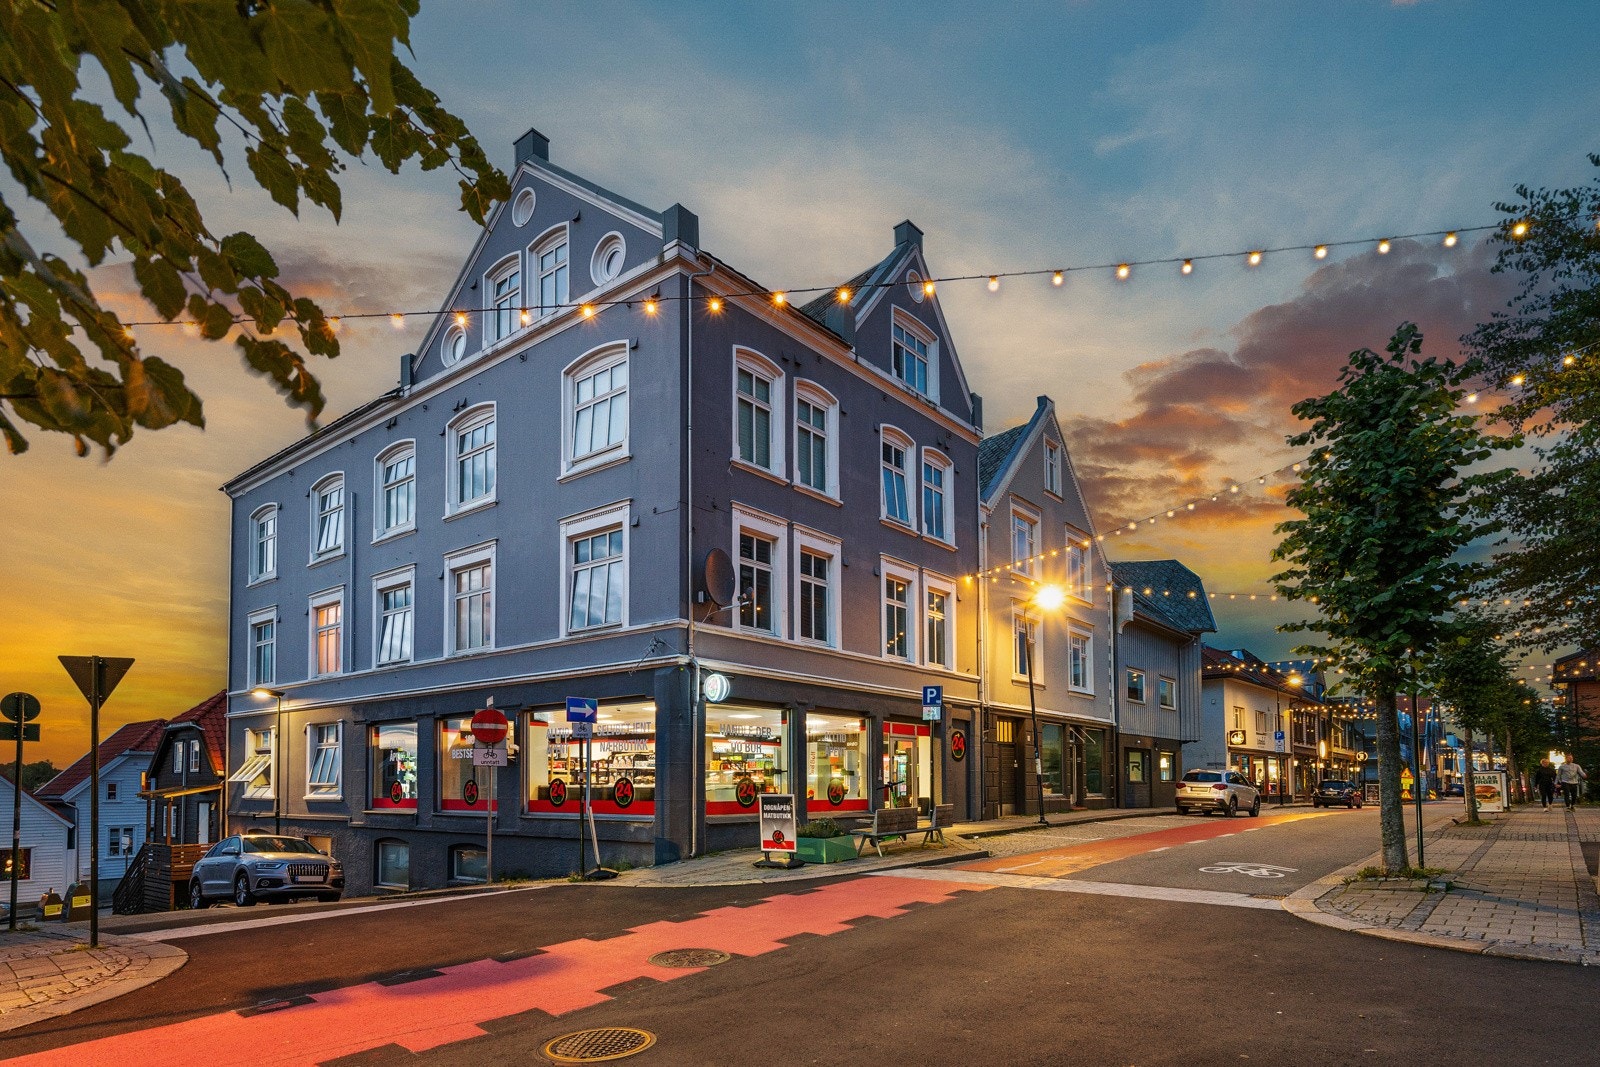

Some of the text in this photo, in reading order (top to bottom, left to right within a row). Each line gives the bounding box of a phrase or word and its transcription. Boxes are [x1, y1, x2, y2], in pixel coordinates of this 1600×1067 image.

[927, 688, 937, 703] P
[596, 722, 652, 736] SELVBETJENT
[756, 726, 772, 738] DER
[600, 739, 648, 752] NÆRBUTIKK
[952, 736, 964, 750] 24
[452, 748, 474, 759] BESTSE
[465, 784, 477, 796] 24
[551, 783, 565, 797] 24
[616, 783, 632, 797] 24
[739, 783, 755, 797] 24
[829, 785, 843, 796] 24
